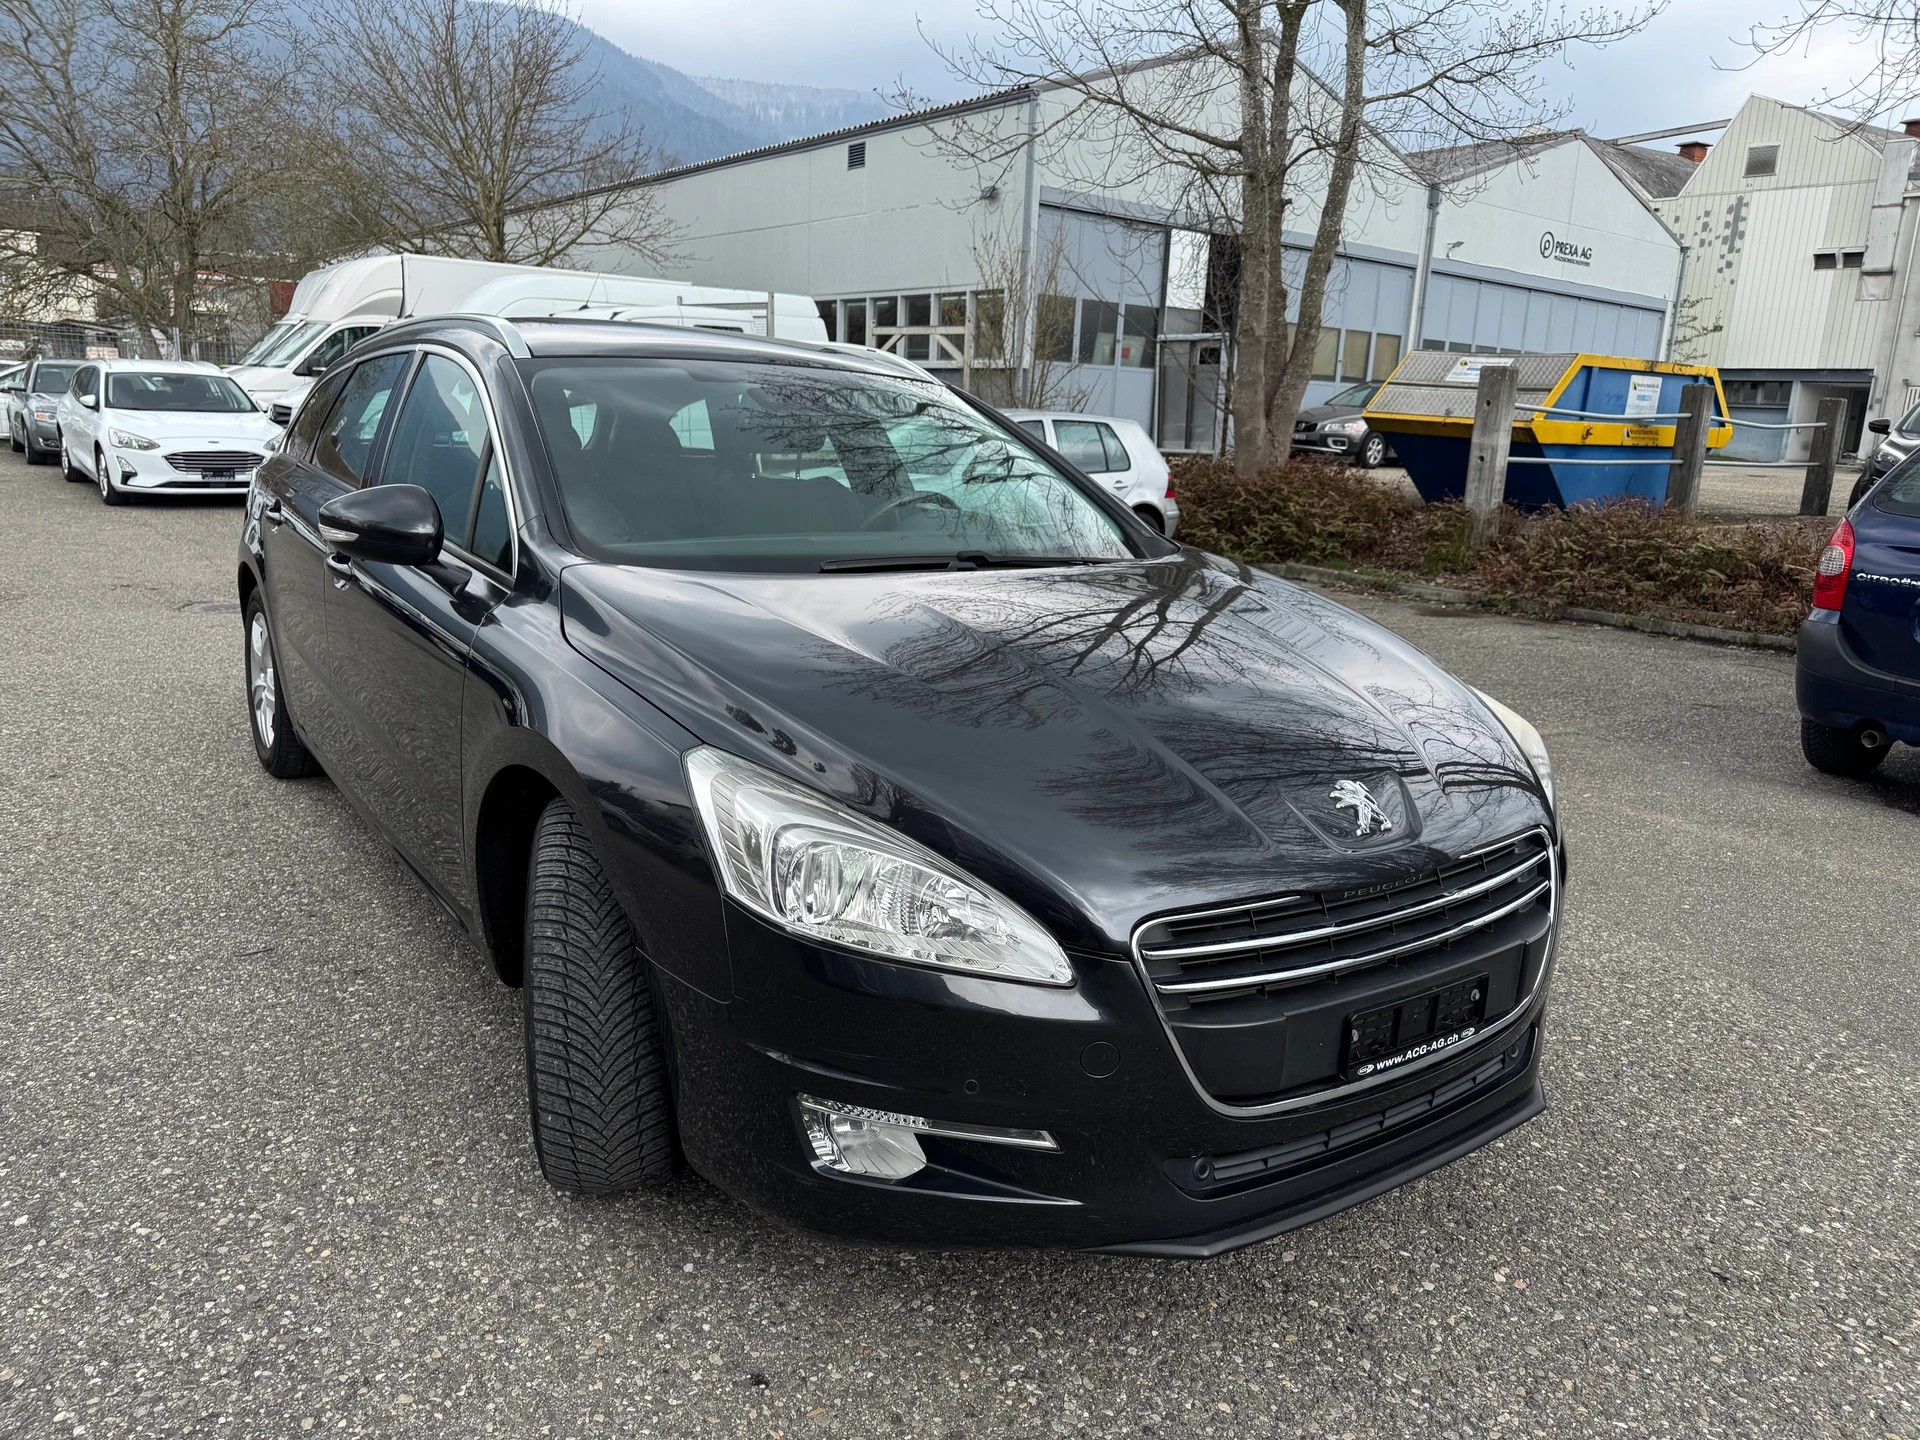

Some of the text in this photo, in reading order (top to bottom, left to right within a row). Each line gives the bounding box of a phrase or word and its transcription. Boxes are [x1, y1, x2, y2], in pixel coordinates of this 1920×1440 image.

[1554, 241, 1592, 260] PREXA AG
[1344, 873, 1424, 898] PEUGEOT
[1376, 1033, 1459, 1070] www.ACG-AG.ch
